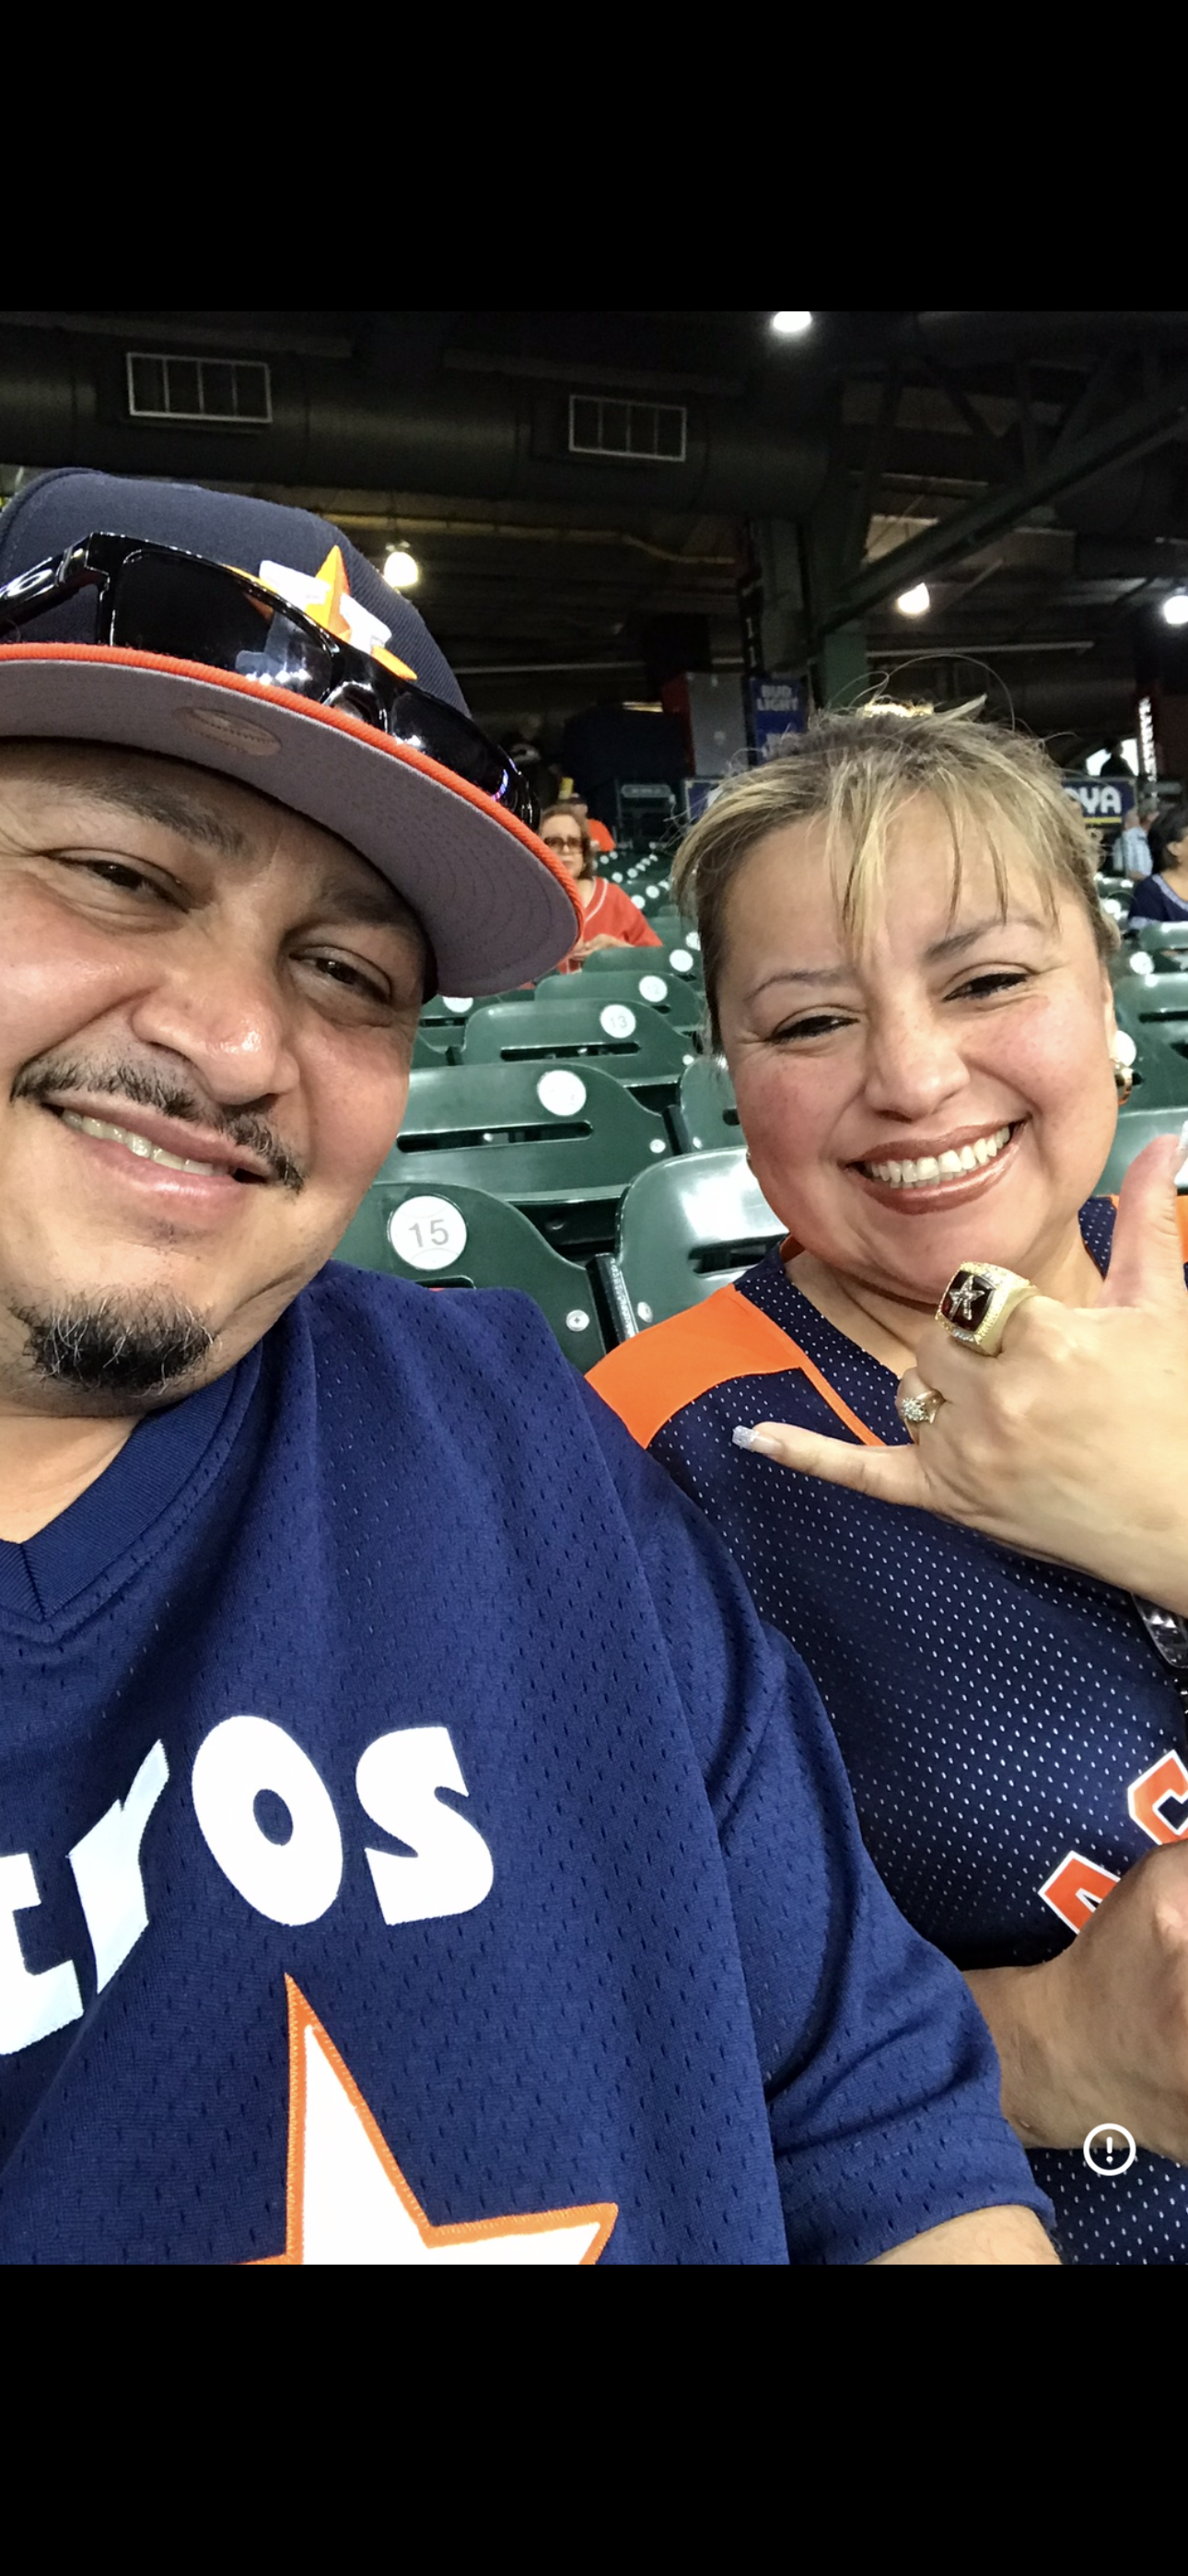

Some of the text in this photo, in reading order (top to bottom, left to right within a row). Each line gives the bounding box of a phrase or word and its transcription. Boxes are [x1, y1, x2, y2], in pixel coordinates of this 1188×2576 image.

[756, 697, 798, 712] LIGHT
[610, 1015, 628, 1029] 13
[408, 1219, 449, 1248] 15
